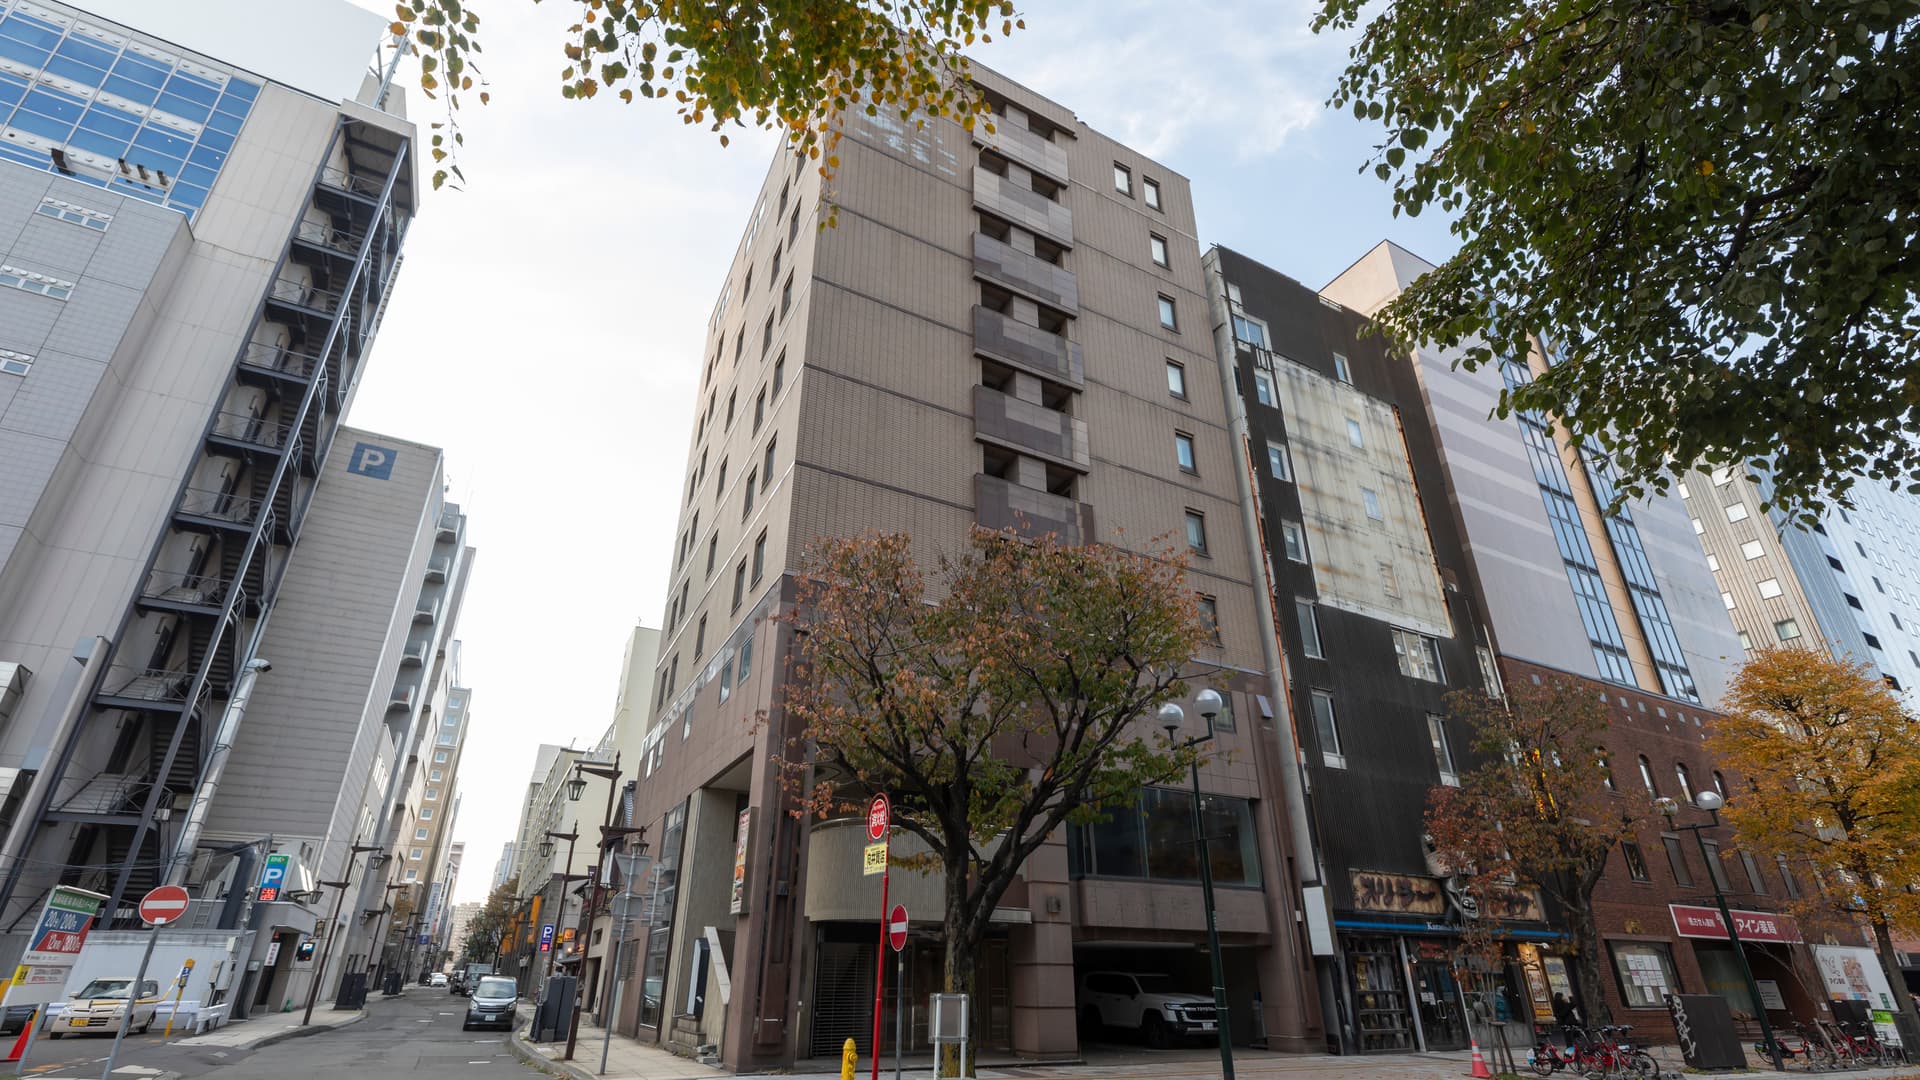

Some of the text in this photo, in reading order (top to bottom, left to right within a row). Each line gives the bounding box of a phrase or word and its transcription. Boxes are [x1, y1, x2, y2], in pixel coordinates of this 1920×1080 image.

[358, 448, 386, 471] P
[263, 868, 283, 884] P
[543, 926, 553, 938] P
[1735, 918, 1778, 935] アイン薬局
[303, 943, 313, 951] P
